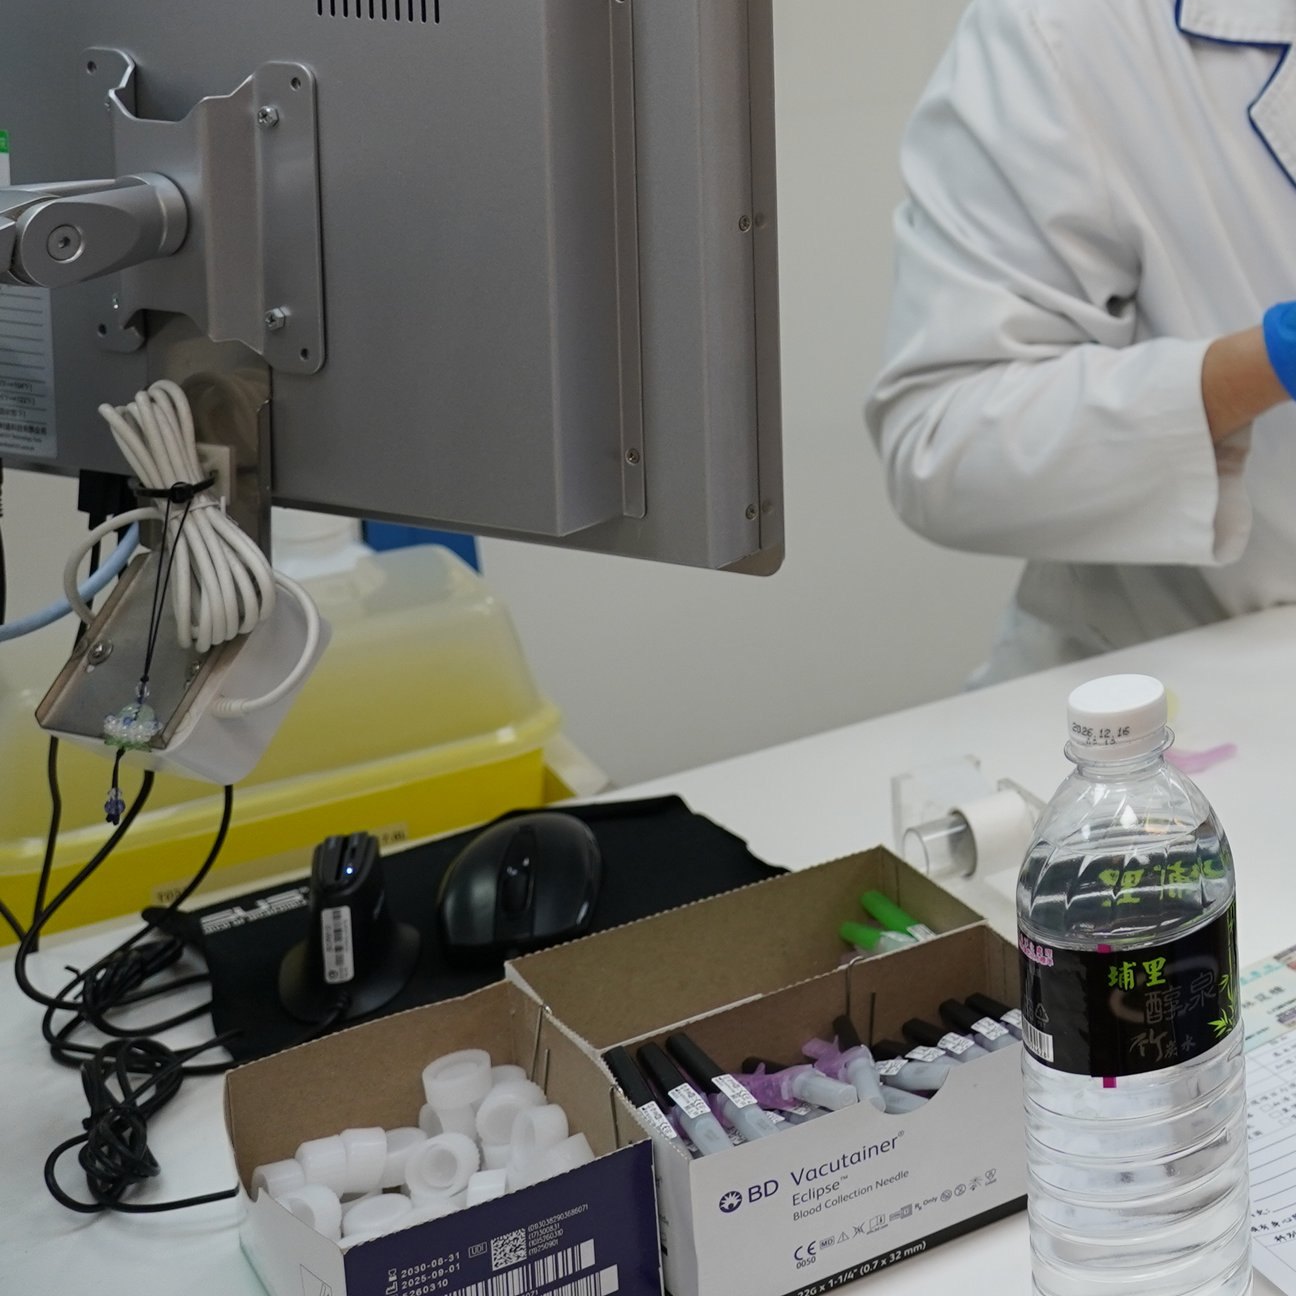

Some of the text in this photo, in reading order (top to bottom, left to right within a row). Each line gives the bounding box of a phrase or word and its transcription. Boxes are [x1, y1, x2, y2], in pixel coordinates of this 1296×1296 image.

[1107, 957, 1168, 991] 埔里
[747, 1179, 780, 1204] BD
[793, 1169, 910, 1221] Blood Collection Needle
[400, 1251, 461, 1279] 2030-08-31
[796, 1256, 817, 1270] 0050
[859, 1259, 879, 1277] (0.7
[889, 1250, 903, 1263] 32
[904, 1240, 927, 1258] mm)
[401, 1263, 461, 1290] 2025-09-01
